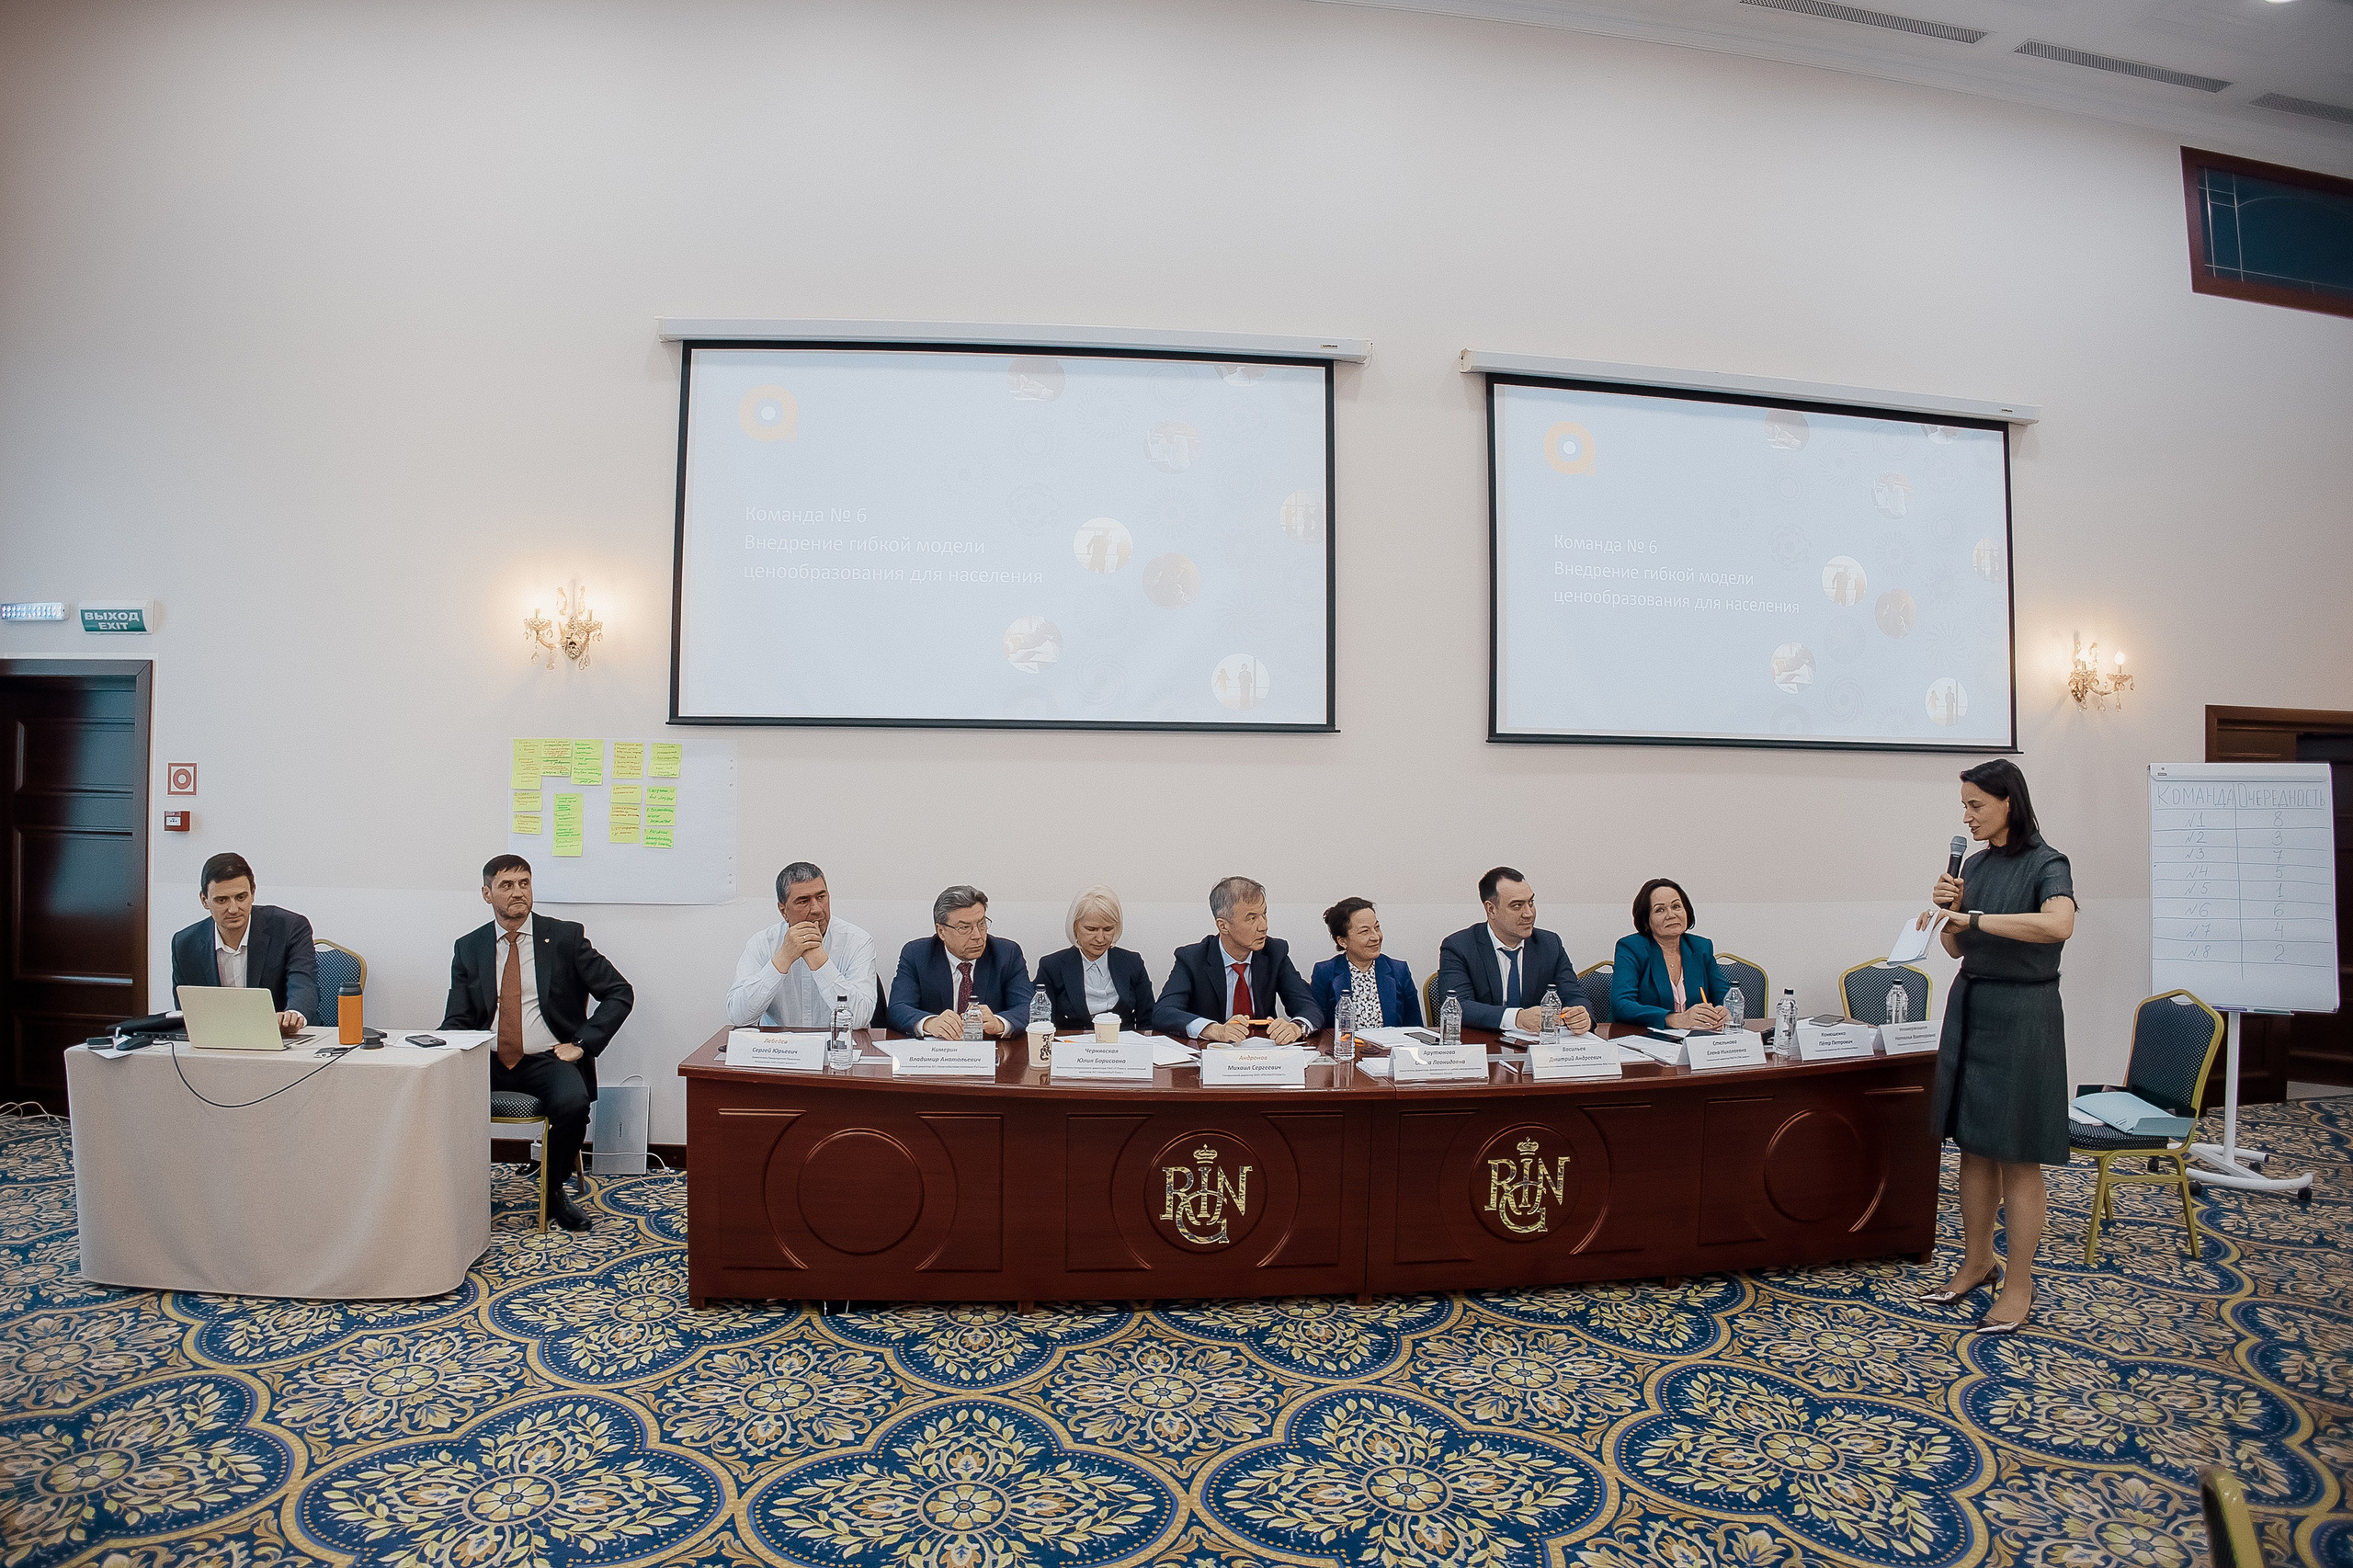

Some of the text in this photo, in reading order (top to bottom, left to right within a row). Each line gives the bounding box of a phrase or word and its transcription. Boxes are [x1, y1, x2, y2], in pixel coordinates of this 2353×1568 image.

[745, 506, 867, 525] Команда № 6
[745, 535, 985, 556] Внедрение гибкой модели
[1554, 535, 1657, 554] Команда № 6
[744, 563, 1042, 584] ценообразования для населения
[1554, 562, 1754, 586] Внедрение гибкой модели
[1554, 590, 1799, 613] ценообразования для населения
[85, 612, 140, 621] ВЫХОД
[2274, 812, 2283, 826] 8
[2272, 831, 2282, 846] 3
[2273, 849, 2282, 863] 7
[2275, 865, 2285, 878] 5
[2276, 882, 2284, 897] 1
[2274, 903, 2284, 916] 6
[2274, 921, 2283, 938] 4
[2274, 944, 2284, 961] 2
